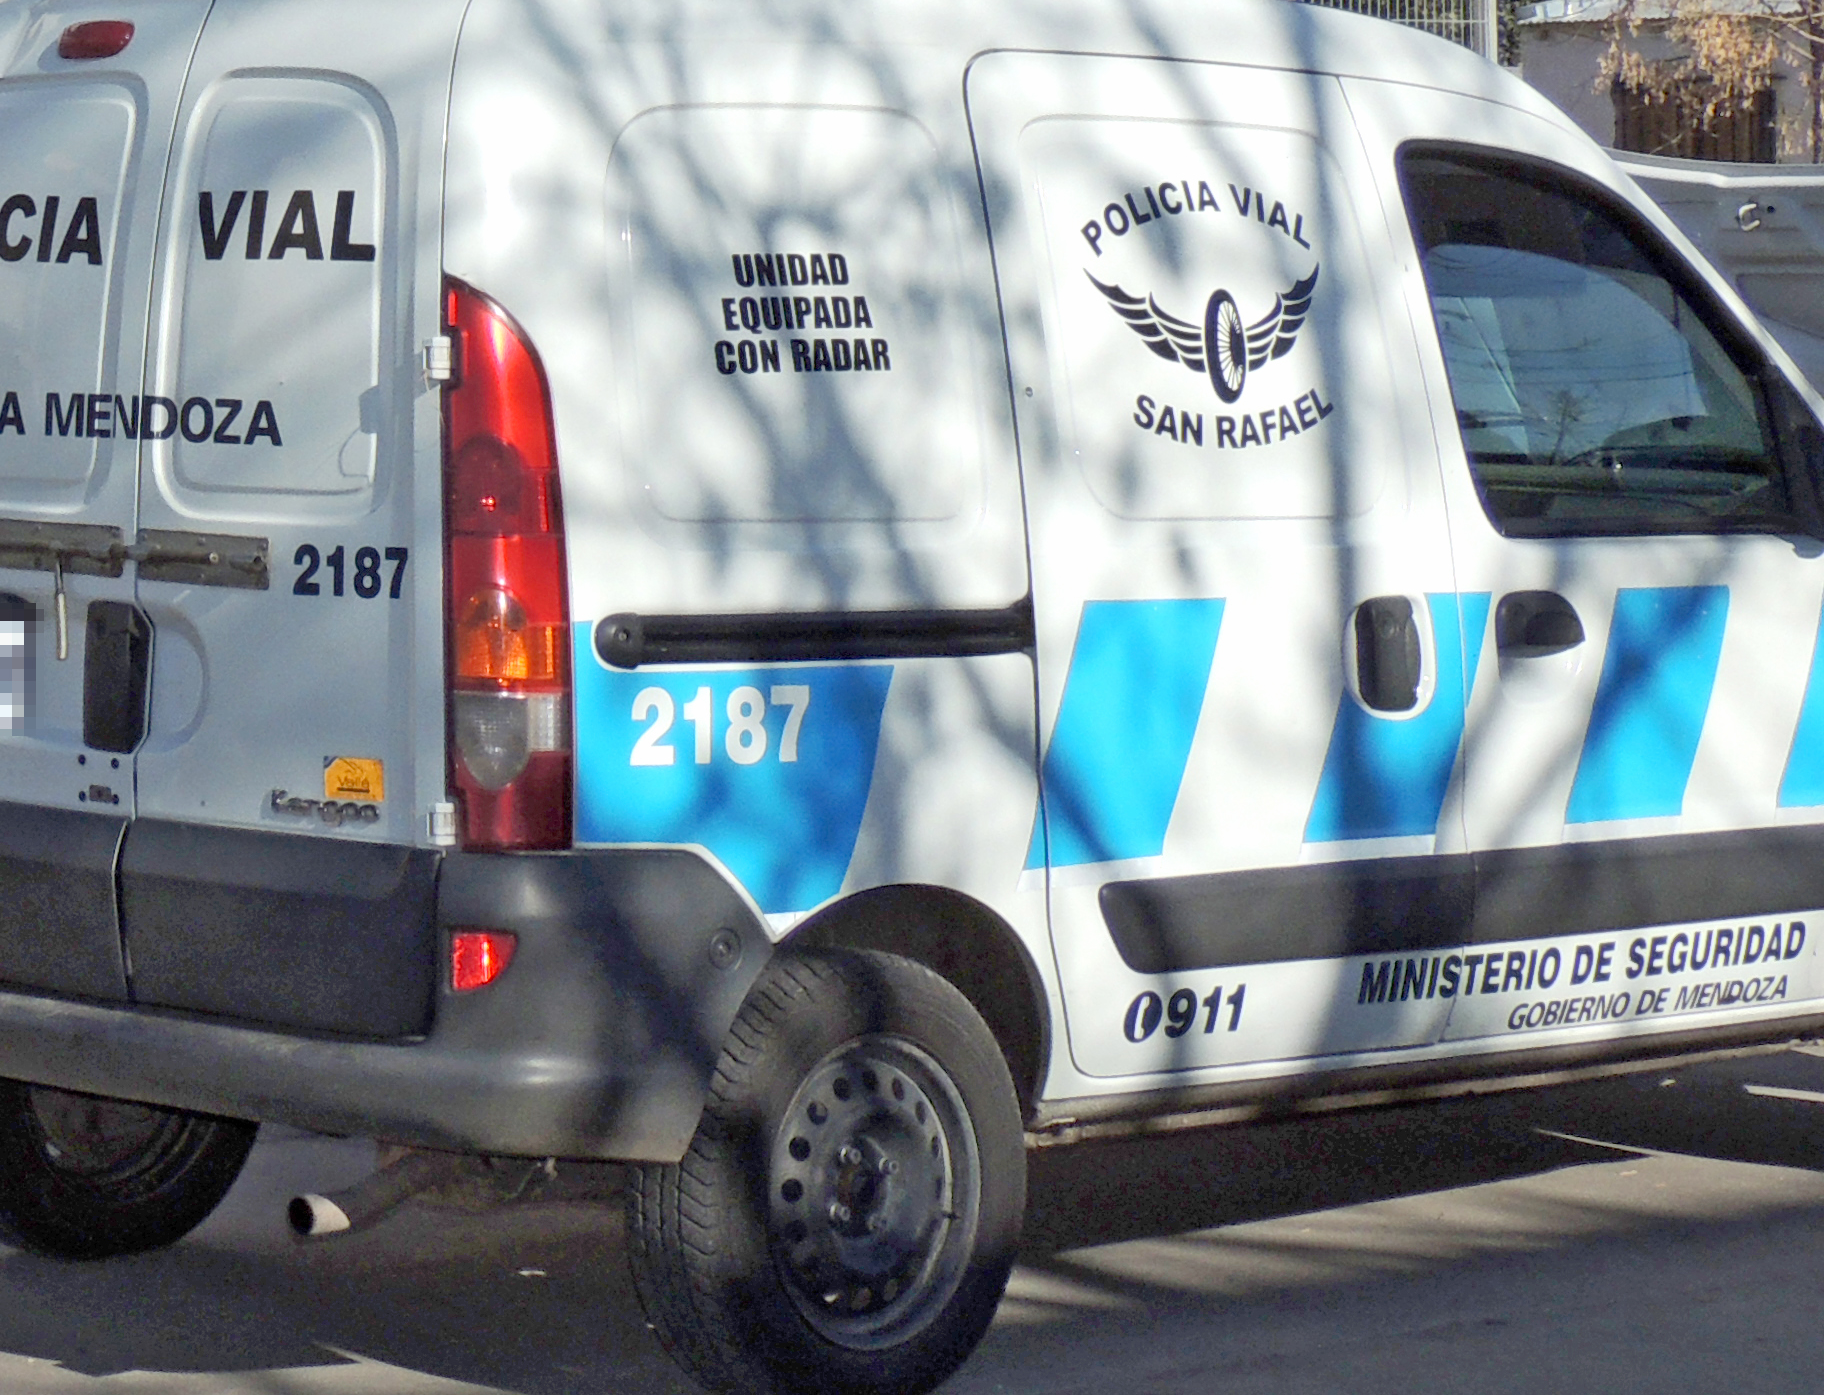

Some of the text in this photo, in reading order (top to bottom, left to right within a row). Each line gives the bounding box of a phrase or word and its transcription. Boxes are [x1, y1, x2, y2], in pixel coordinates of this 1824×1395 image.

[197, 190, 376, 261] VIAL
[1081, 180, 1311, 258] POLICIA VIAL
[732, 253, 849, 288] UNIDAD
[722, 296, 873, 334] EQUIPADA
[714, 338, 891, 375] CON RADAR
[45, 392, 283, 447] MENDOZA
[1133, 388, 1334, 448] SAN RAFAEL
[293, 544, 409, 599] 2187
[629, 685, 810, 767] 2187
[1358, 921, 1806, 1004] MINISTERIO DE SEGURIDAD
[1508, 975, 1788, 1030] GOBIERNO DE MENDOZA
